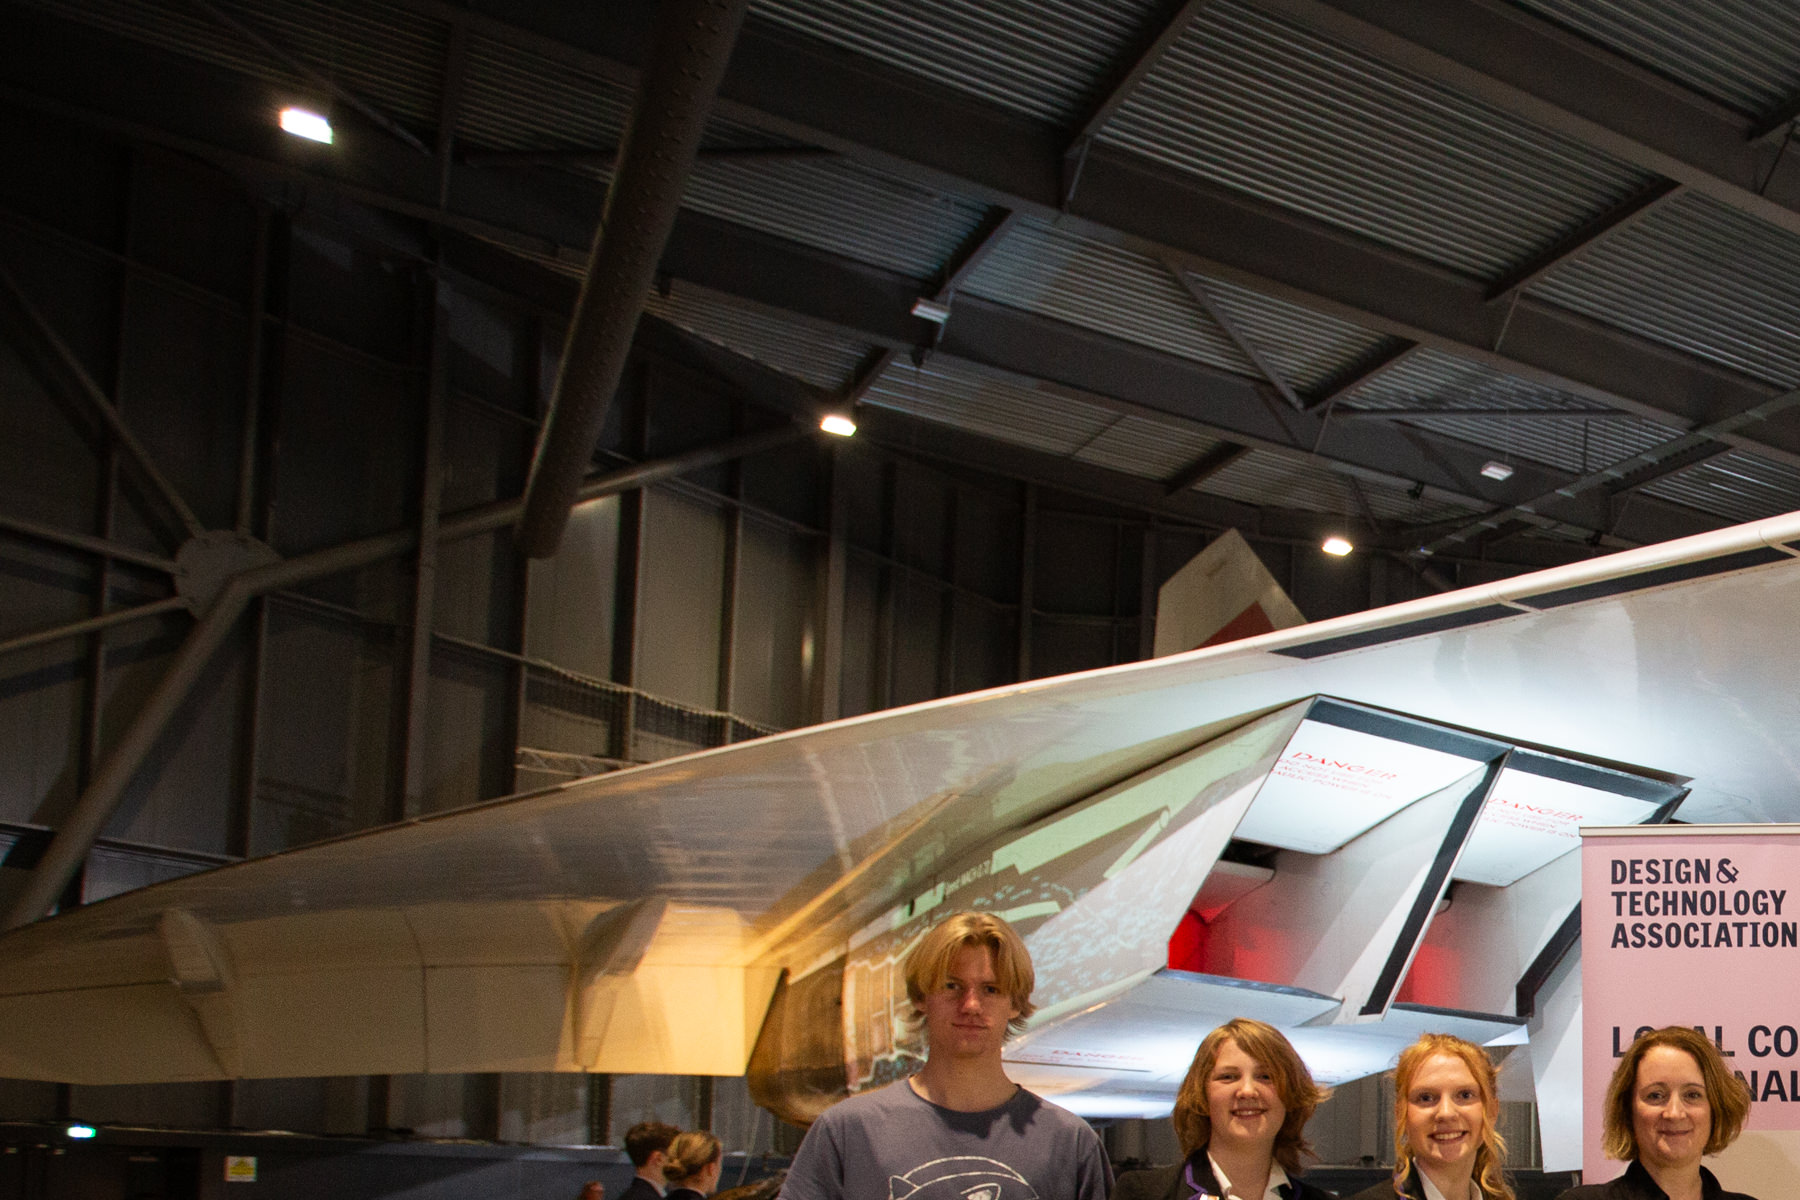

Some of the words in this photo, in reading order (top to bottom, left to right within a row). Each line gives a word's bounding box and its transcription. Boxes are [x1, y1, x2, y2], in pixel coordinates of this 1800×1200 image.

[1292, 752, 1398, 780] DANGER
[1611, 858, 1711, 885] DESIGN
[1716, 858, 1740, 884] &
[1611, 889, 1787, 917] TECHNOLOGY
[1611, 921, 1798, 949] ASSOCIATION
[1612, 1025, 1735, 1058] LAL
